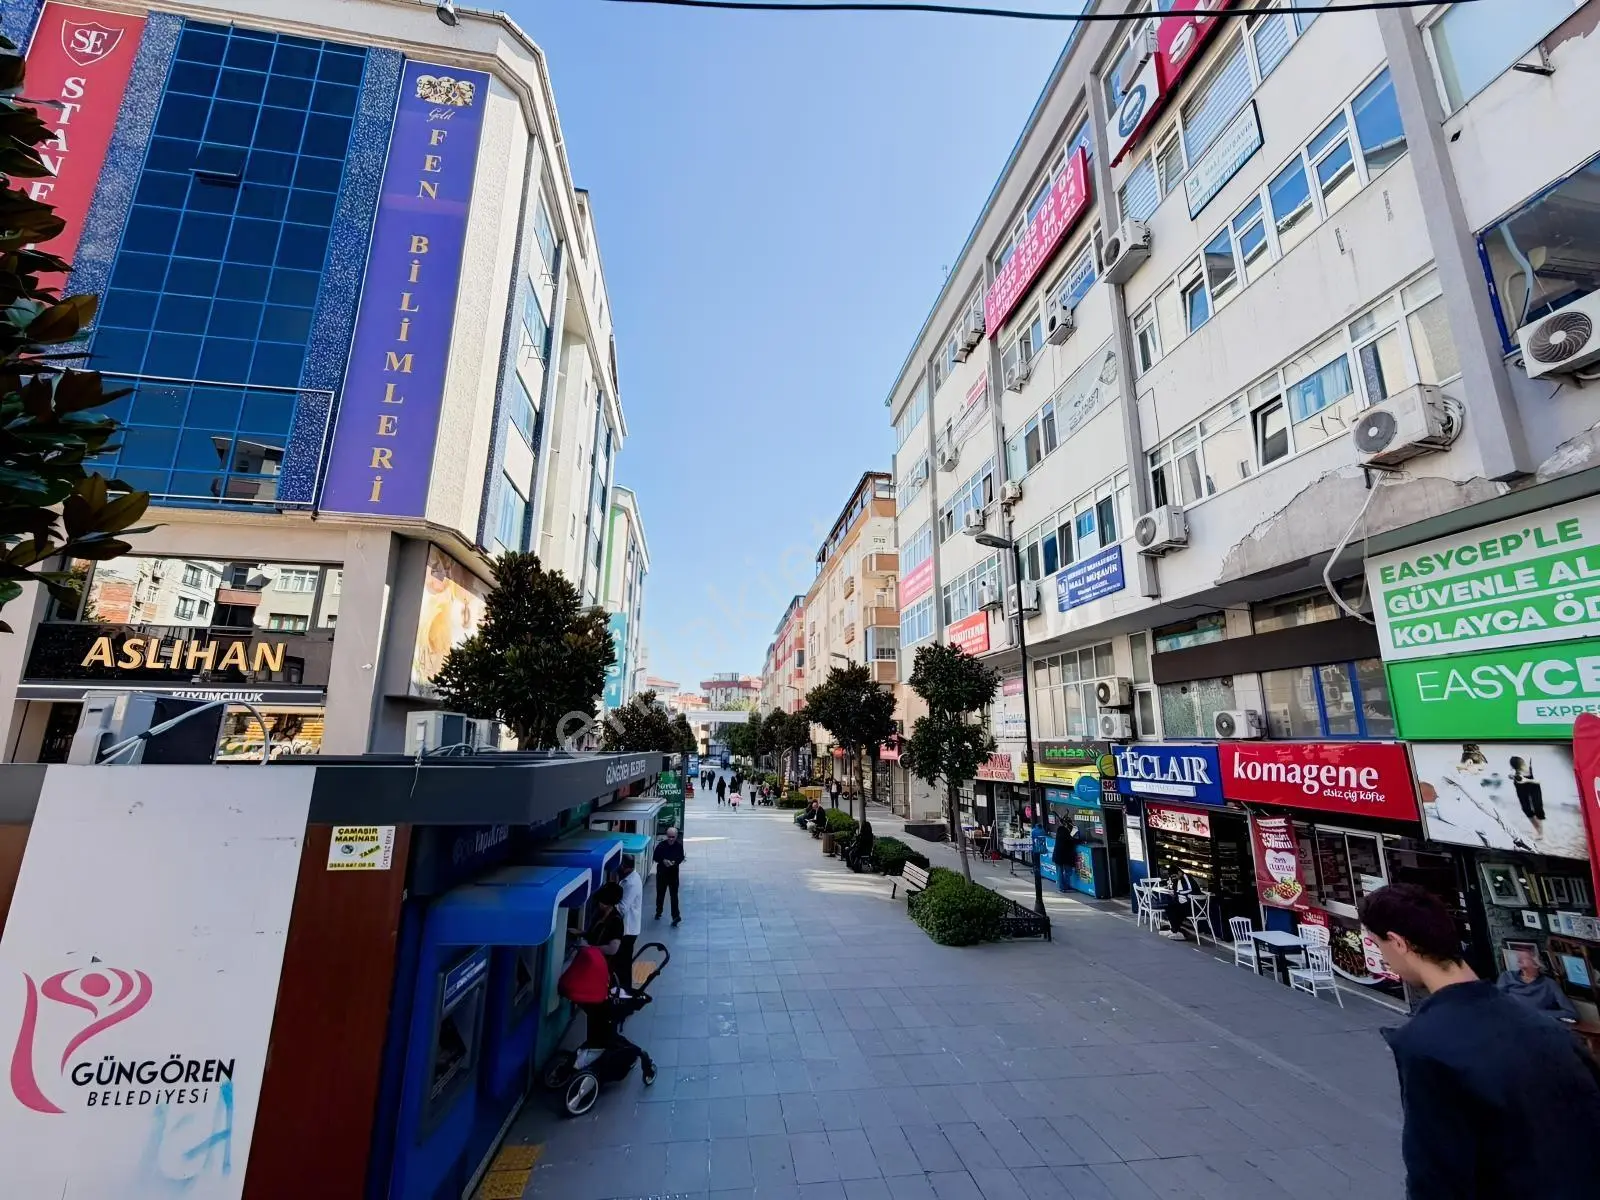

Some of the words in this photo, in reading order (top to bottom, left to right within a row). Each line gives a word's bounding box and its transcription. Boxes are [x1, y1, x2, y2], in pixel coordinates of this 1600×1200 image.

[70, 28, 108, 55] SE
[417, 129, 448, 200] FEN
[368, 234, 429, 502] BİLİMLERİ
[1380, 518, 1583, 585] EASYCEP'LE
[1068, 576, 1085, 590] MALİ
[1086, 563, 1118, 583] MÜŞAVİR
[1389, 567, 1539, 614] GÜVENLE
[1393, 606, 1548, 646] KOLAYCA
[82, 636, 287, 672] ASLIHAN
[172, 690, 264, 702] KUYUMCULUK
[1233, 752, 1379, 795] komagene
[1359, 790, 1386, 803] köfte
[71, 1054, 235, 1086] GÜNGÖREN
